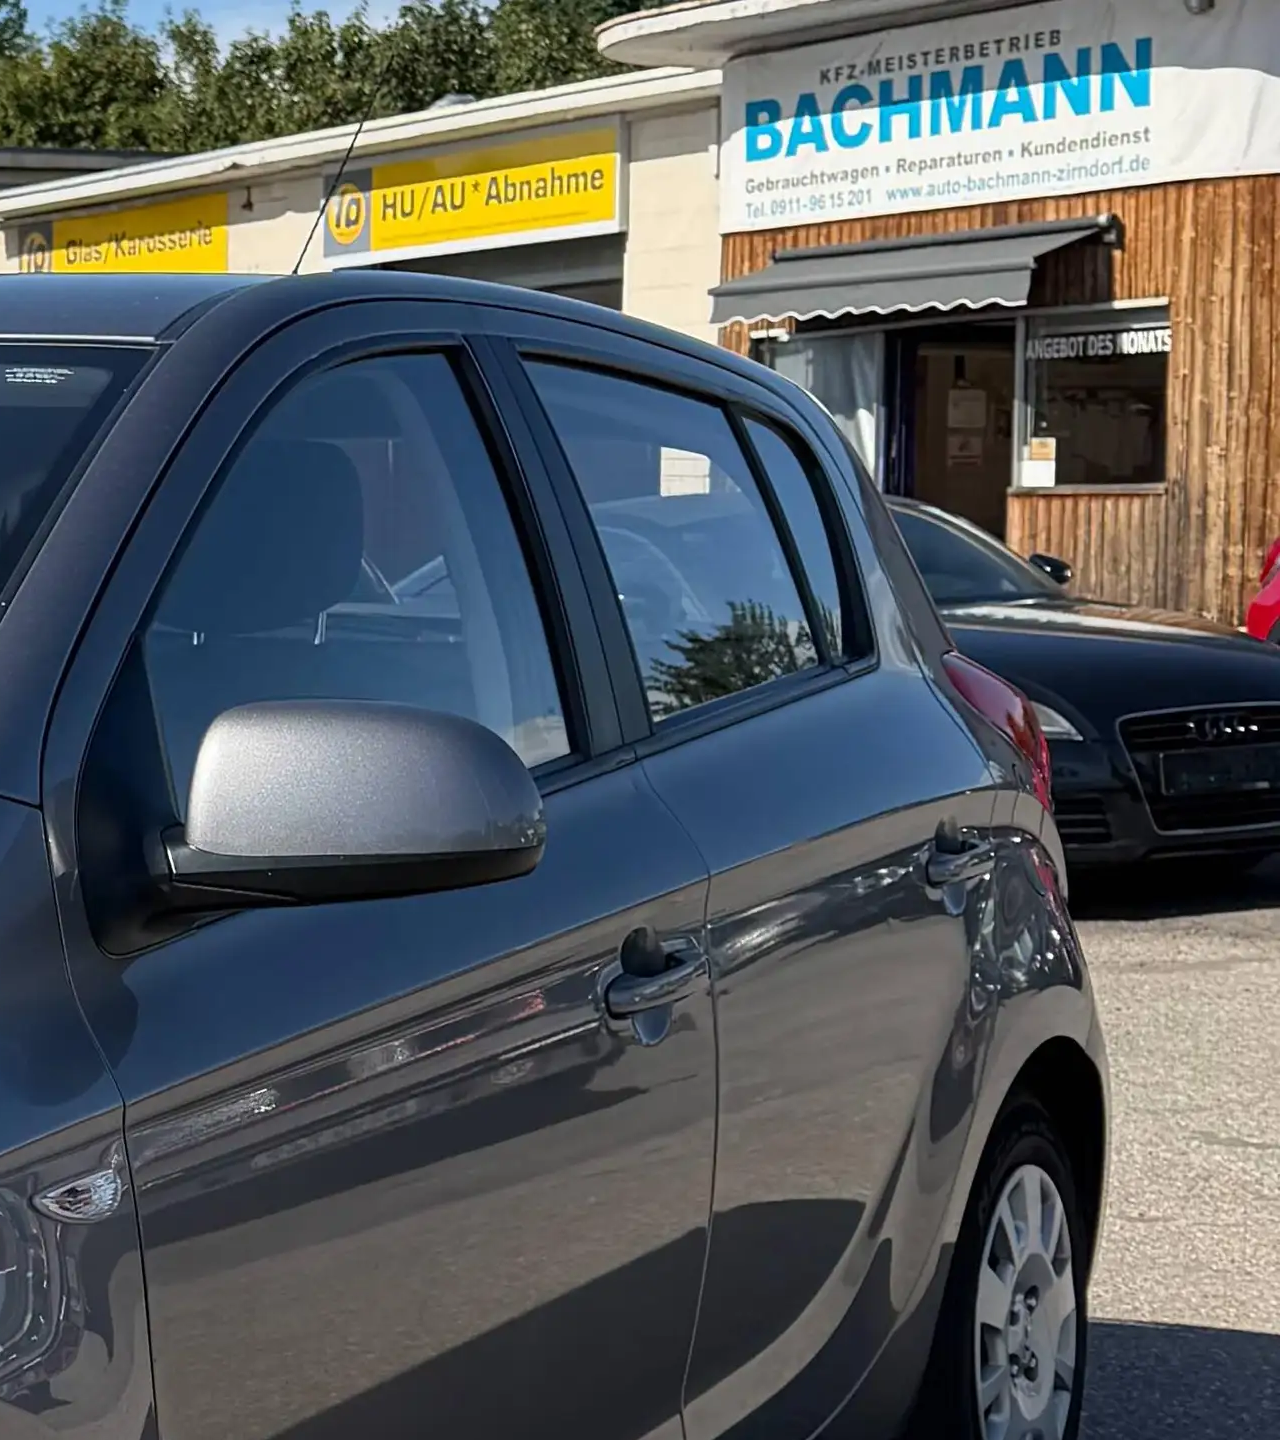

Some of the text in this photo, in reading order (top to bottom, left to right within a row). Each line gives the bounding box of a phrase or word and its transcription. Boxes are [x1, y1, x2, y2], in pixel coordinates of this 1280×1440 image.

[819, 29, 1062, 86] KFZ-MEISTERBETRIEB
[744, 37, 1153, 163] BACHMANN
[745, 127, 1151, 195] Gebrauchtwagen Reparaturen Kundendienst
[885, 155, 1151, 201] www.auto-bachmann-zirndorf.de
[484, 167, 605, 207] Abnahme
[1025, 336, 1085, 360] ANGEBOT
[1087, 333, 1114, 356] DES
